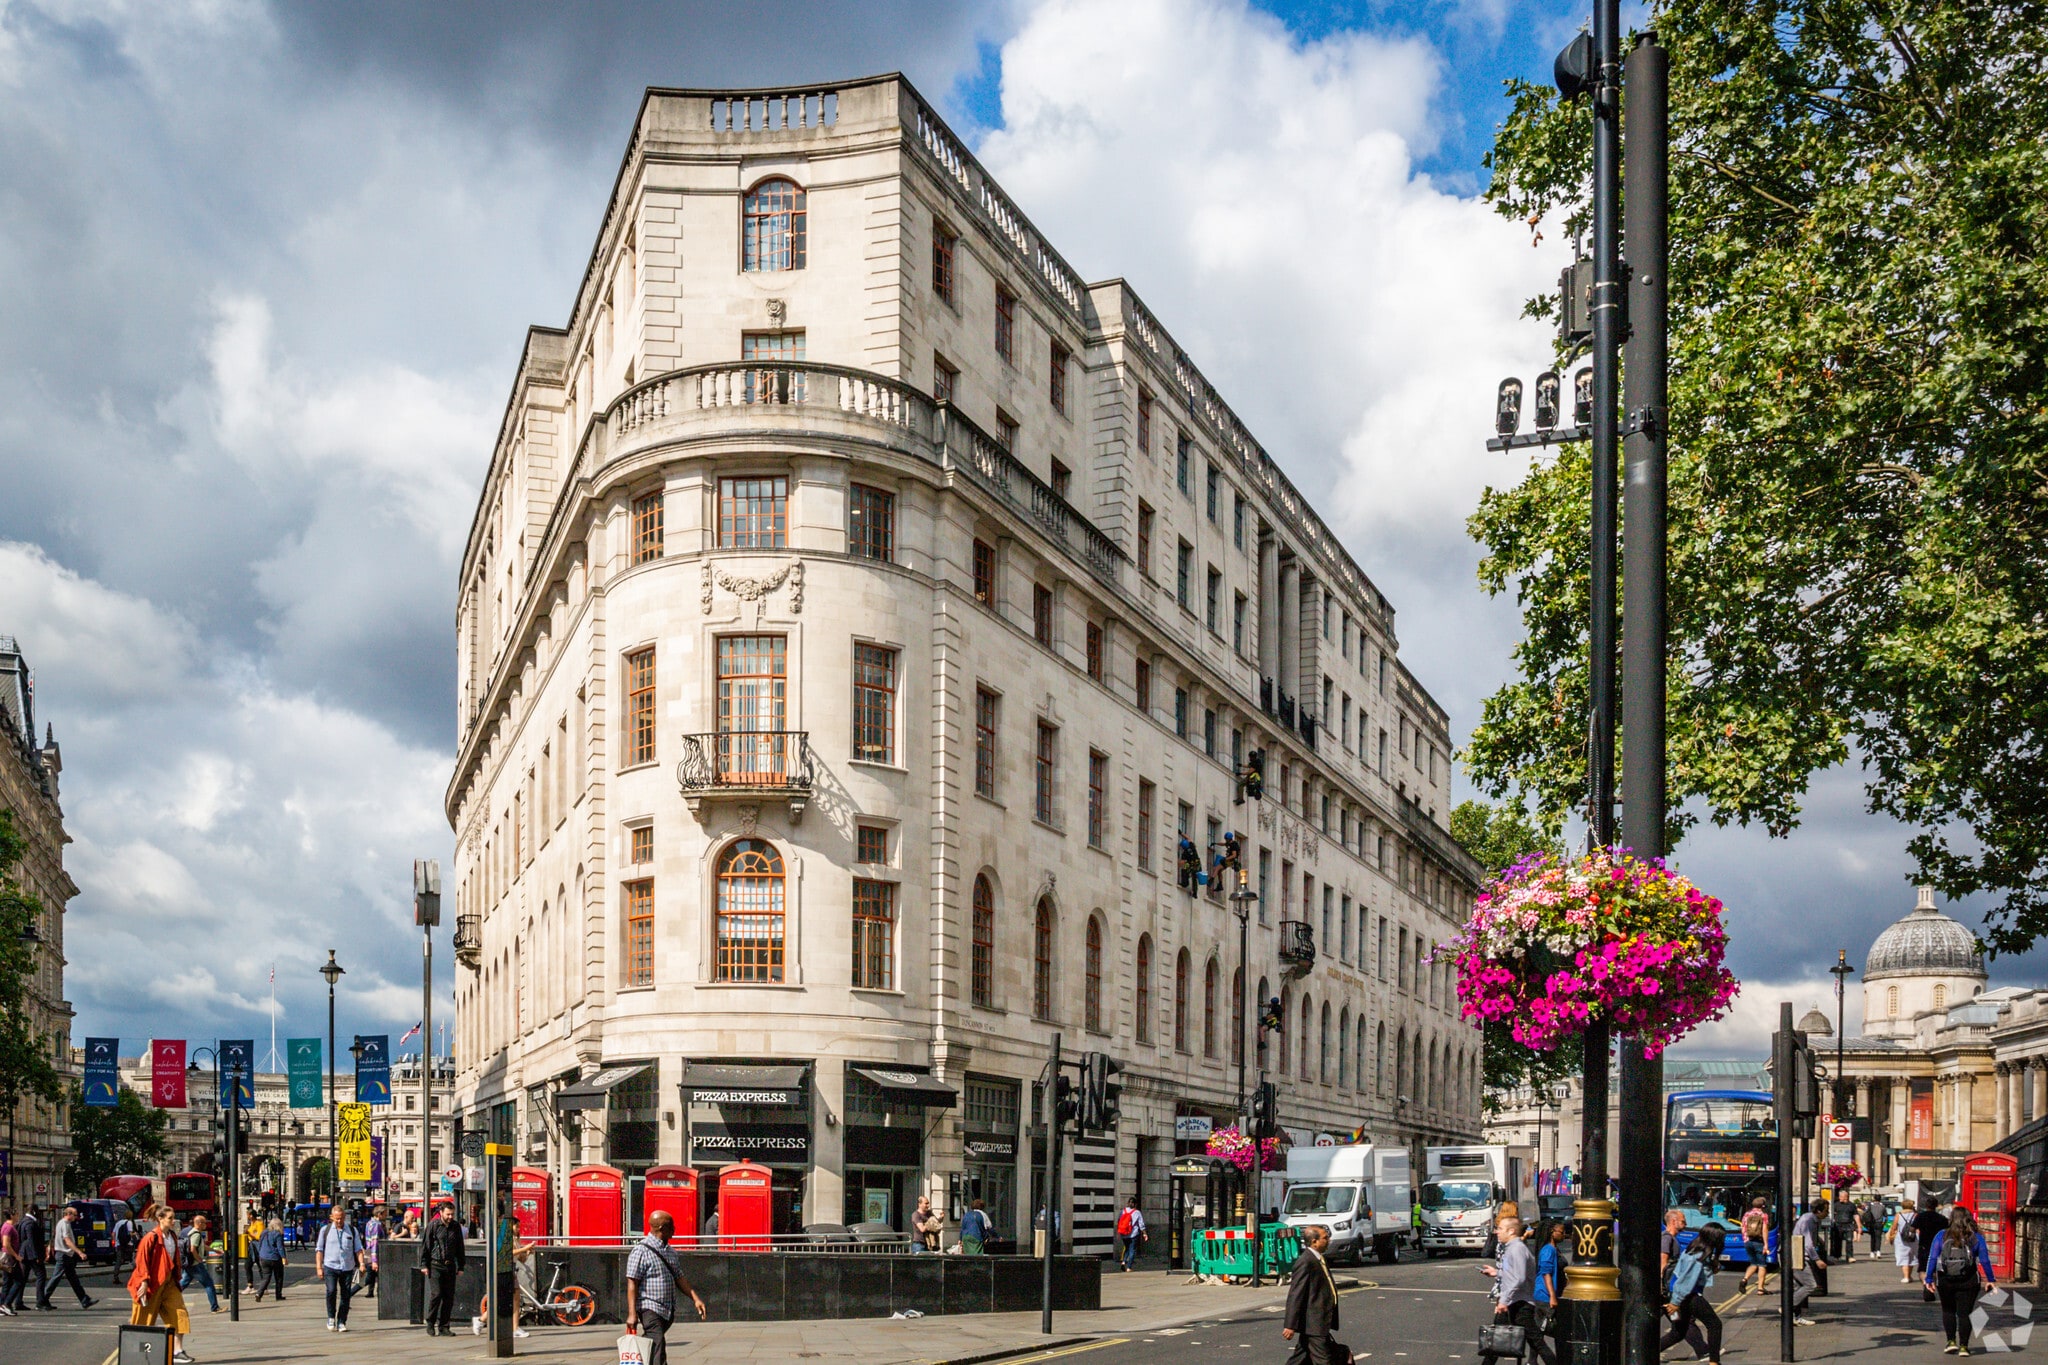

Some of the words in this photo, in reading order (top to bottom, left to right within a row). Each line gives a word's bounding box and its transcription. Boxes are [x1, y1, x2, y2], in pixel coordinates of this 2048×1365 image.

[730, 1092, 787, 1103] EXPRESS
[1823, 1114, 1830, 1122] G
[737, 1137, 806, 1149] EXPRESS
